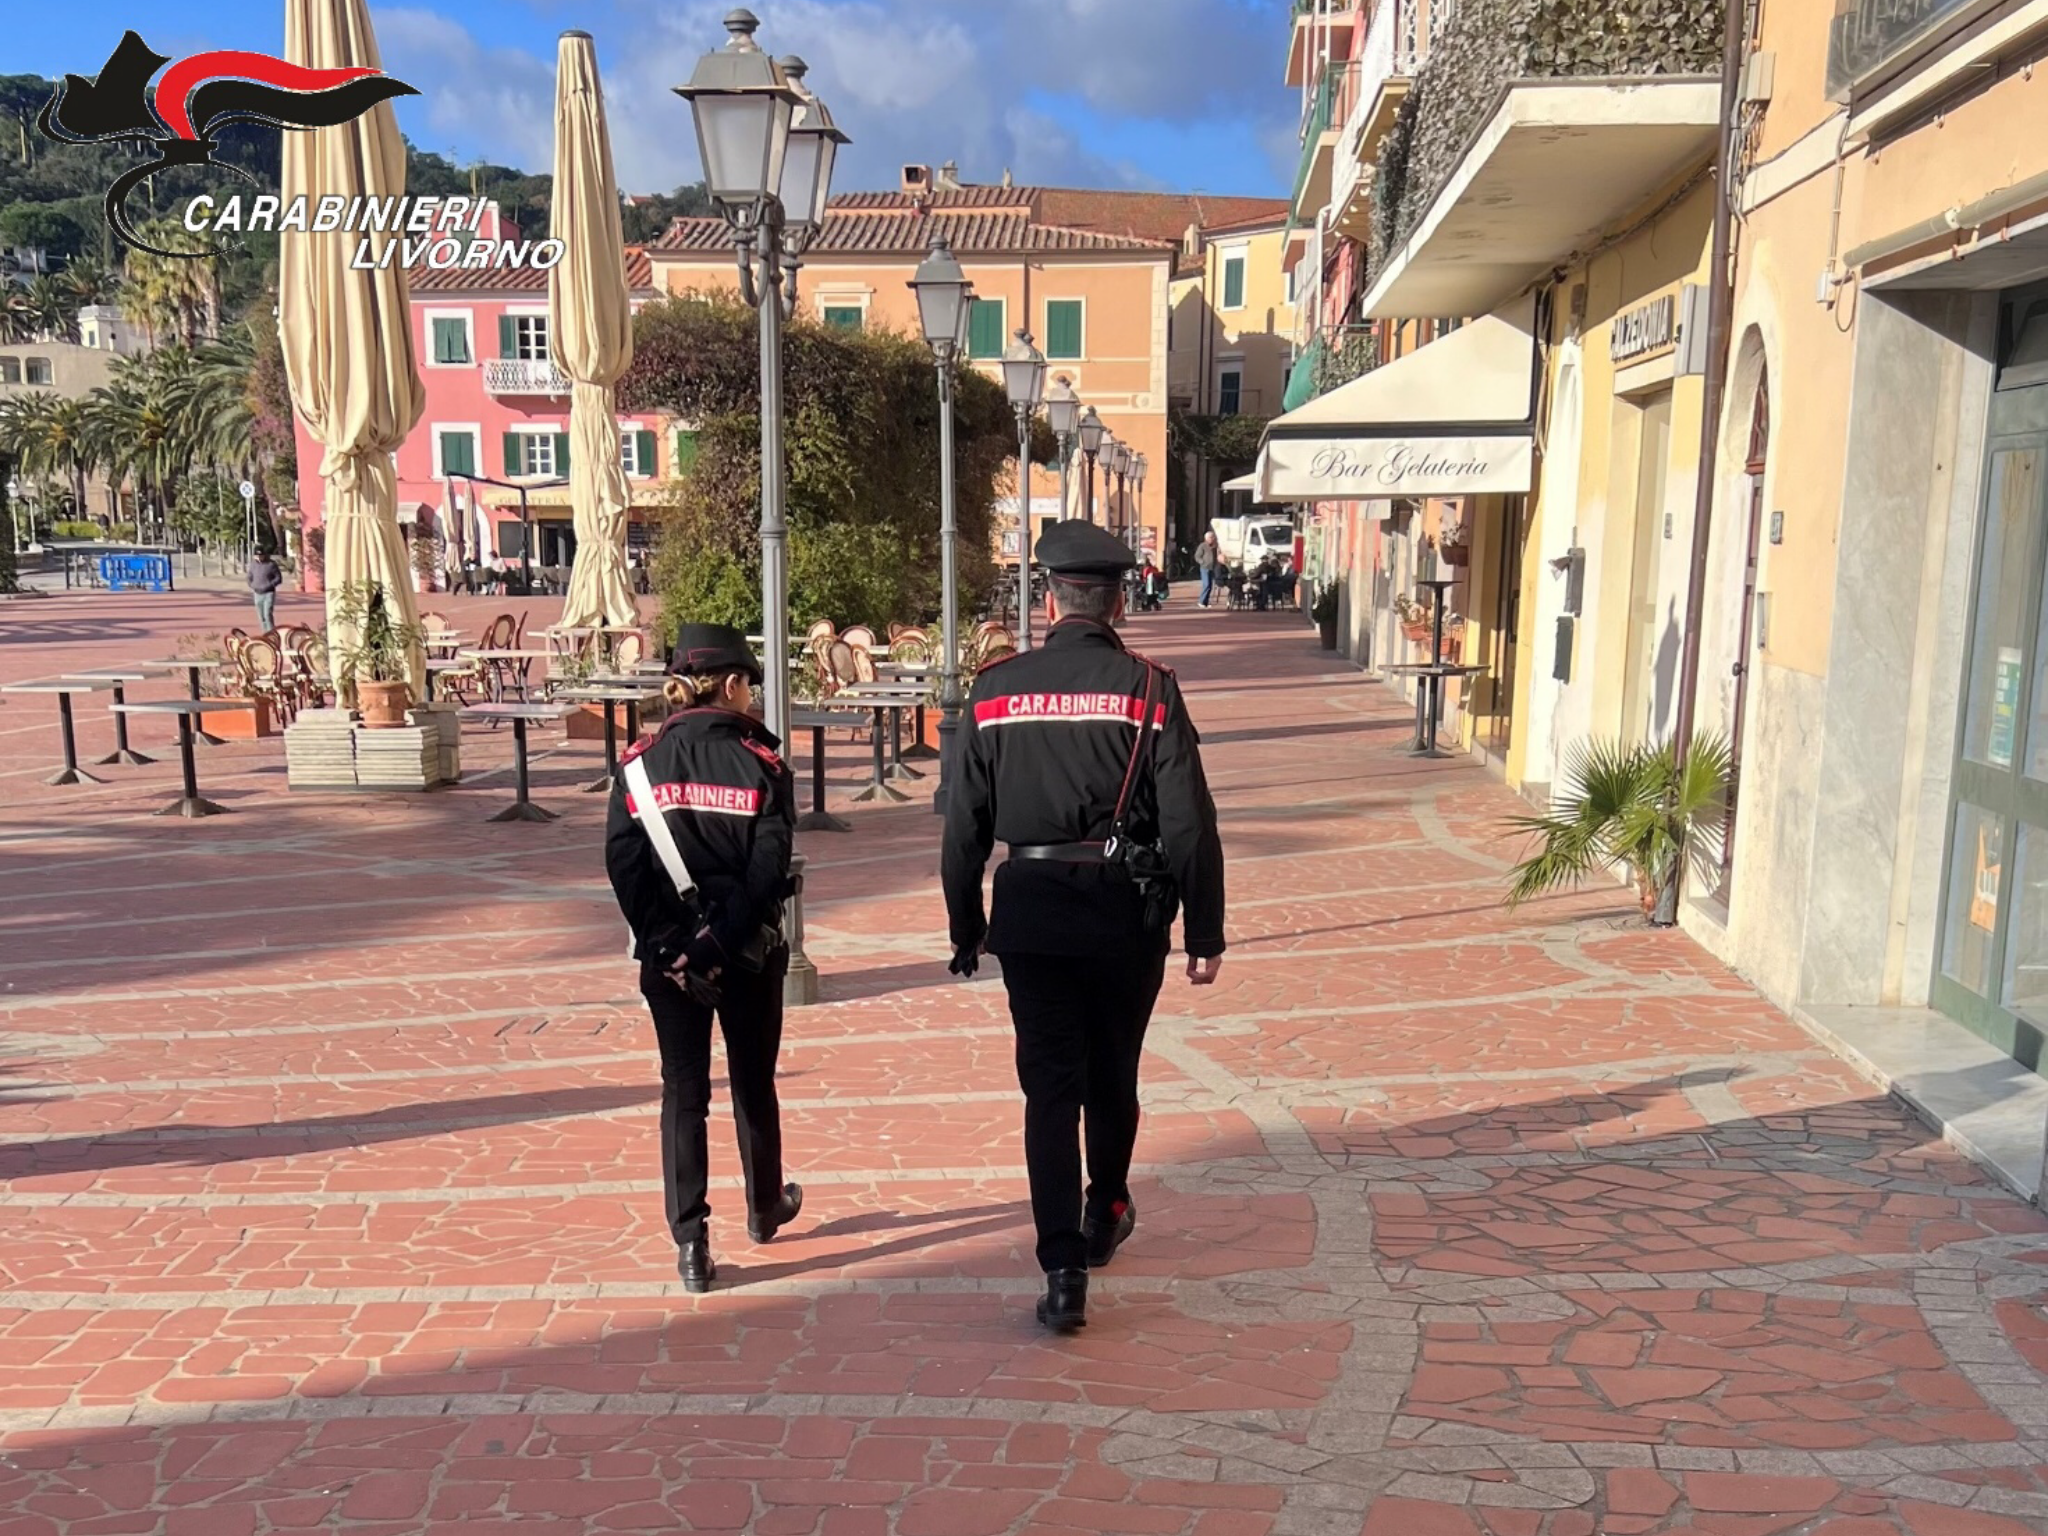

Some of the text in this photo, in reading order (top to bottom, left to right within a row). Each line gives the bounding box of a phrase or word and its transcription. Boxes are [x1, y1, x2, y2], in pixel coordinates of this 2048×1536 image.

[1310, 444, 1488, 486] Bar Gelateria
[1008, 694, 1128, 715] CARABINIERI
